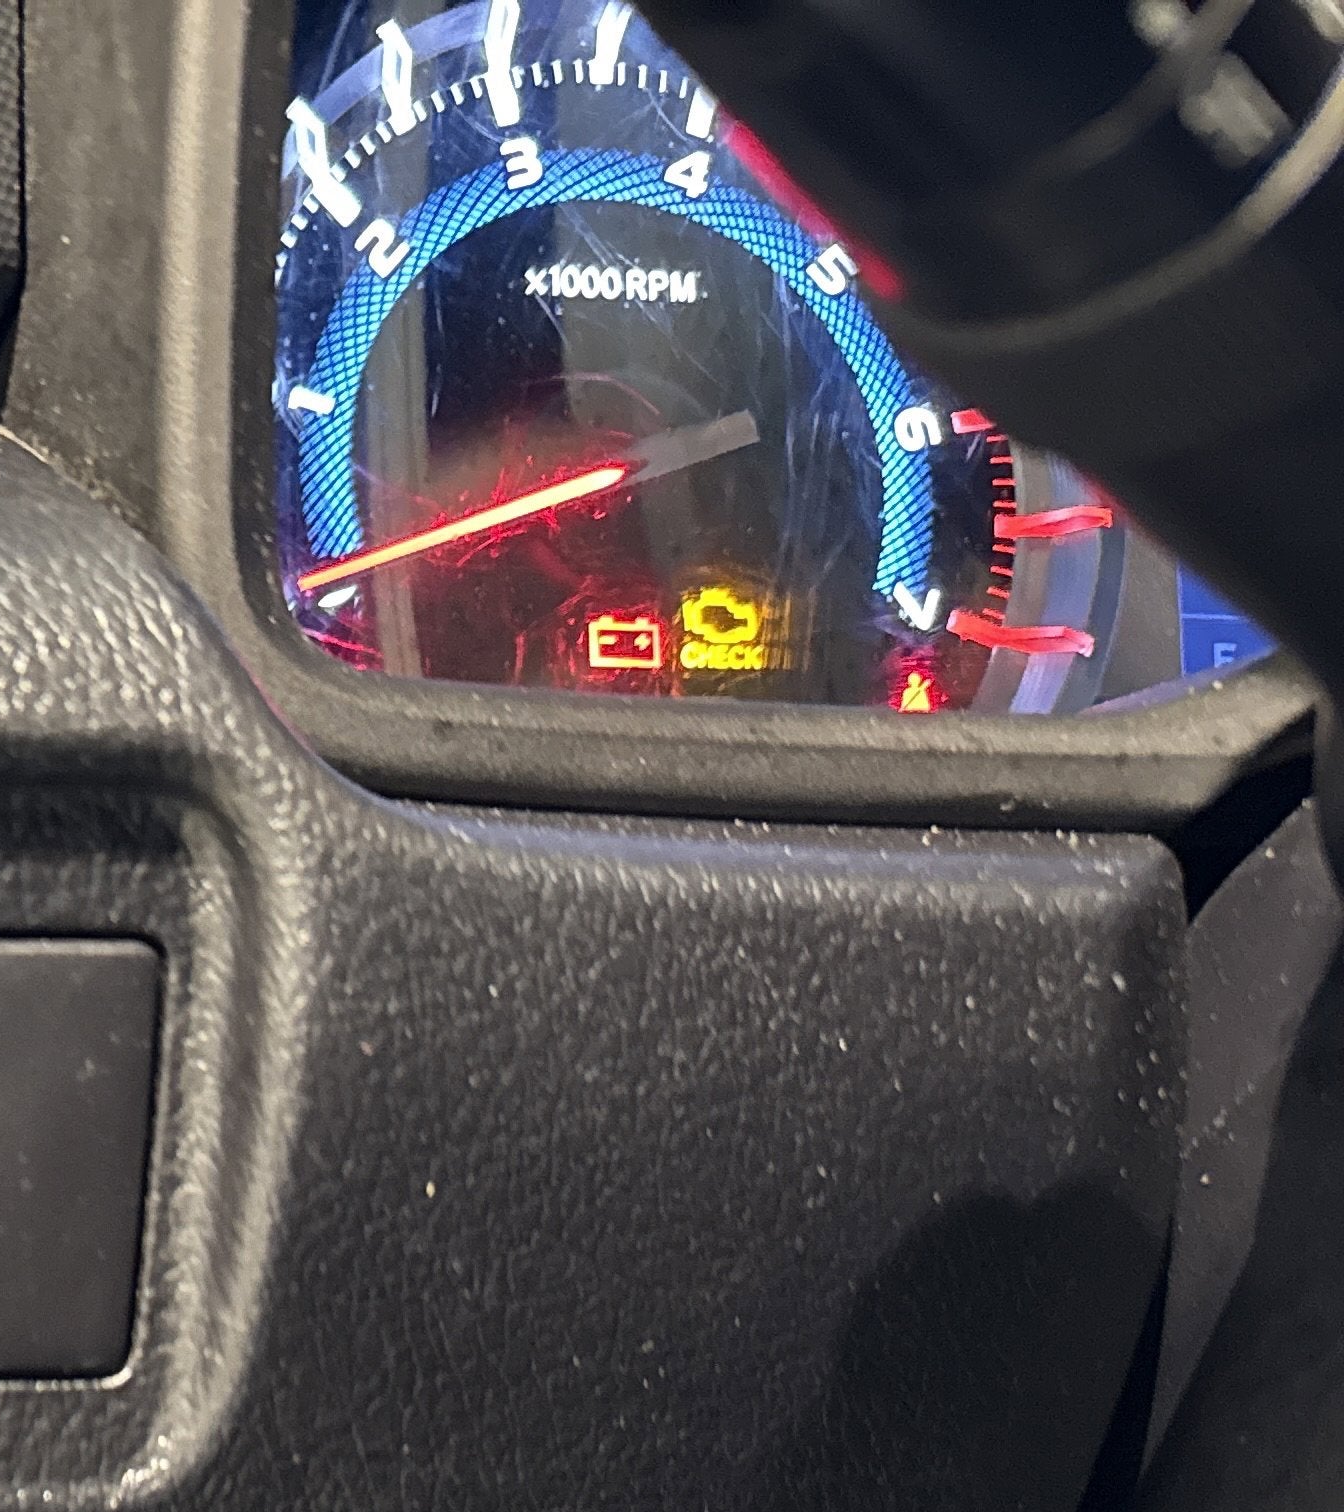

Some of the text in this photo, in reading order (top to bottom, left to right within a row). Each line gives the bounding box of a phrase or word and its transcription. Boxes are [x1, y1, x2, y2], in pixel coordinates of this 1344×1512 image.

[499, 136, 543, 190] 3
[664, 150, 712, 198] 4
[354, 218, 411, 278] 2
[805, 243, 858, 295] 5
[287, 385, 336, 414] 1
[894, 406, 942, 452] 6
[893, 581, 941, 631] 7
[680, 641, 765, 670] CHECK
